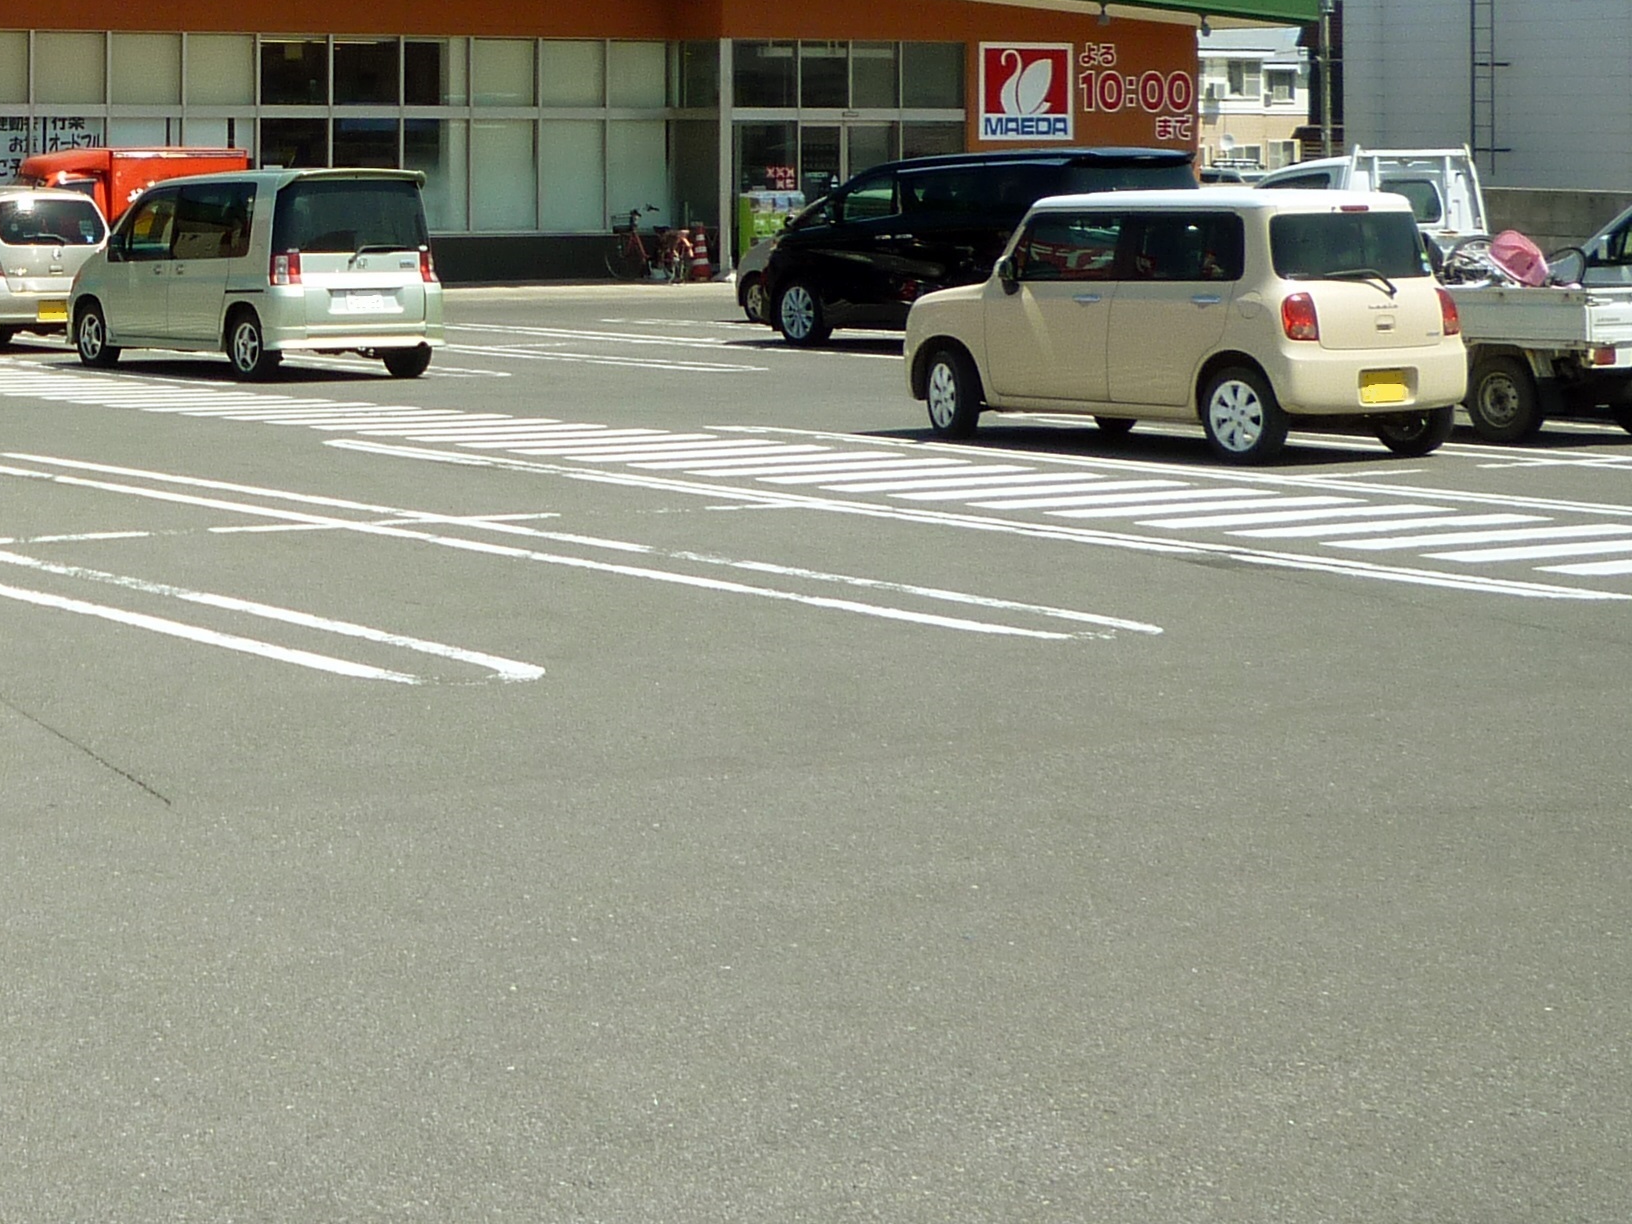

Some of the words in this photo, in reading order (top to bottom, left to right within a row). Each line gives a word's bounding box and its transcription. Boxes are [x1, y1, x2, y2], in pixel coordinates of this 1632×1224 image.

[1079, 42, 1116, 66] よる
[1079, 70, 1194, 113] 10:00
[984, 117, 1068, 136] MAEDA
[1155, 114, 1192, 140] まで
